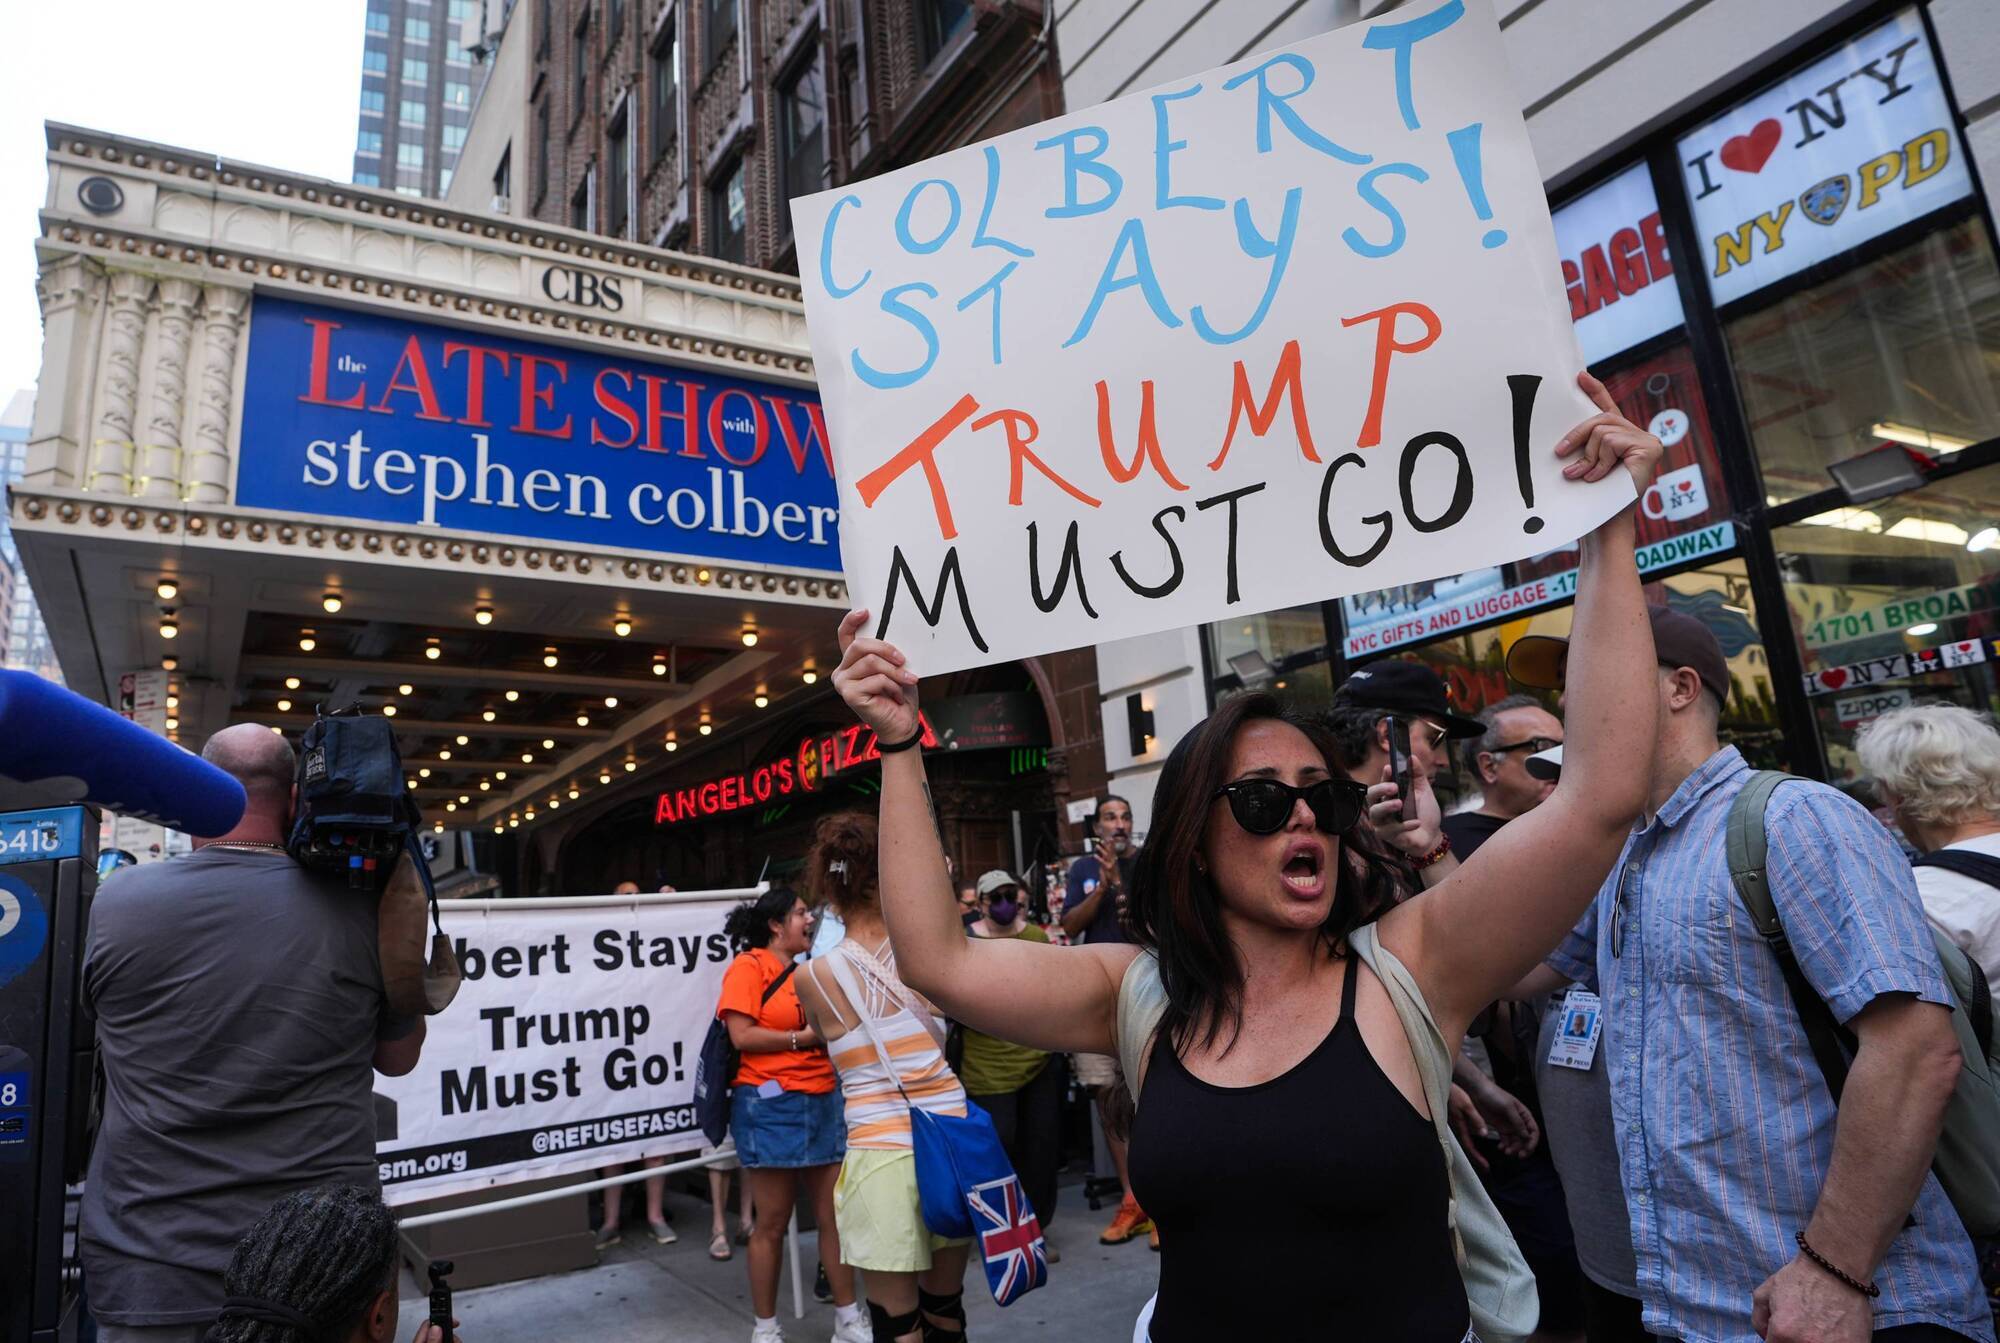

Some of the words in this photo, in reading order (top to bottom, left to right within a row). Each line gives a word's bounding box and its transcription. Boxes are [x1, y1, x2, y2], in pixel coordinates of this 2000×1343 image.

[820, 1, 1464, 299] COLBERT
[1687, 150, 1722, 200] I
[1786, 37, 1918, 149] NY
[1714, 200, 1794, 277] NY
[1858, 129, 1950, 210] PD
[542, 265, 623, 312] CBS
[298, 317, 573, 439] LATE
[591, 368, 836, 479] SHOW
[337, 354, 367, 374] the
[723, 417, 755, 434] with
[856, 301, 1442, 540] TRUMP
[303, 429, 612, 527] stephen
[628, 467, 839, 545] colber
[876, 482, 1266, 653] MUST
[1318, 374, 1543, 568] GO!
[1671, 491, 1696, 509] NY
[1350, 633, 1377, 654] NYC
[1382, 619, 1425, 644] GIFTS
[1429, 609, 1462, 630] AND
[1466, 583, 1548, 620] LUGGAGE
[1635, 526, 1725, 569] OADWAY
[1807, 611, 1874, 643] -1701
[1805, 673, 1820, 694] I
[1851, 656, 1900, 685] NY
[1840, 695, 1903, 717] zippo
[655, 757, 794, 824] ANGELO'S
[821, 708, 938, 779] PIZZ
[455, 934, 570, 981] bert
[480, 1003, 650, 1051] Trump
[441, 1056, 581, 1116] Must
[603, 1041, 684, 1091] Go!
[378, 1151, 467, 1181] sm.org
[533, 1107, 698, 1153] @REFUSEFASCI
